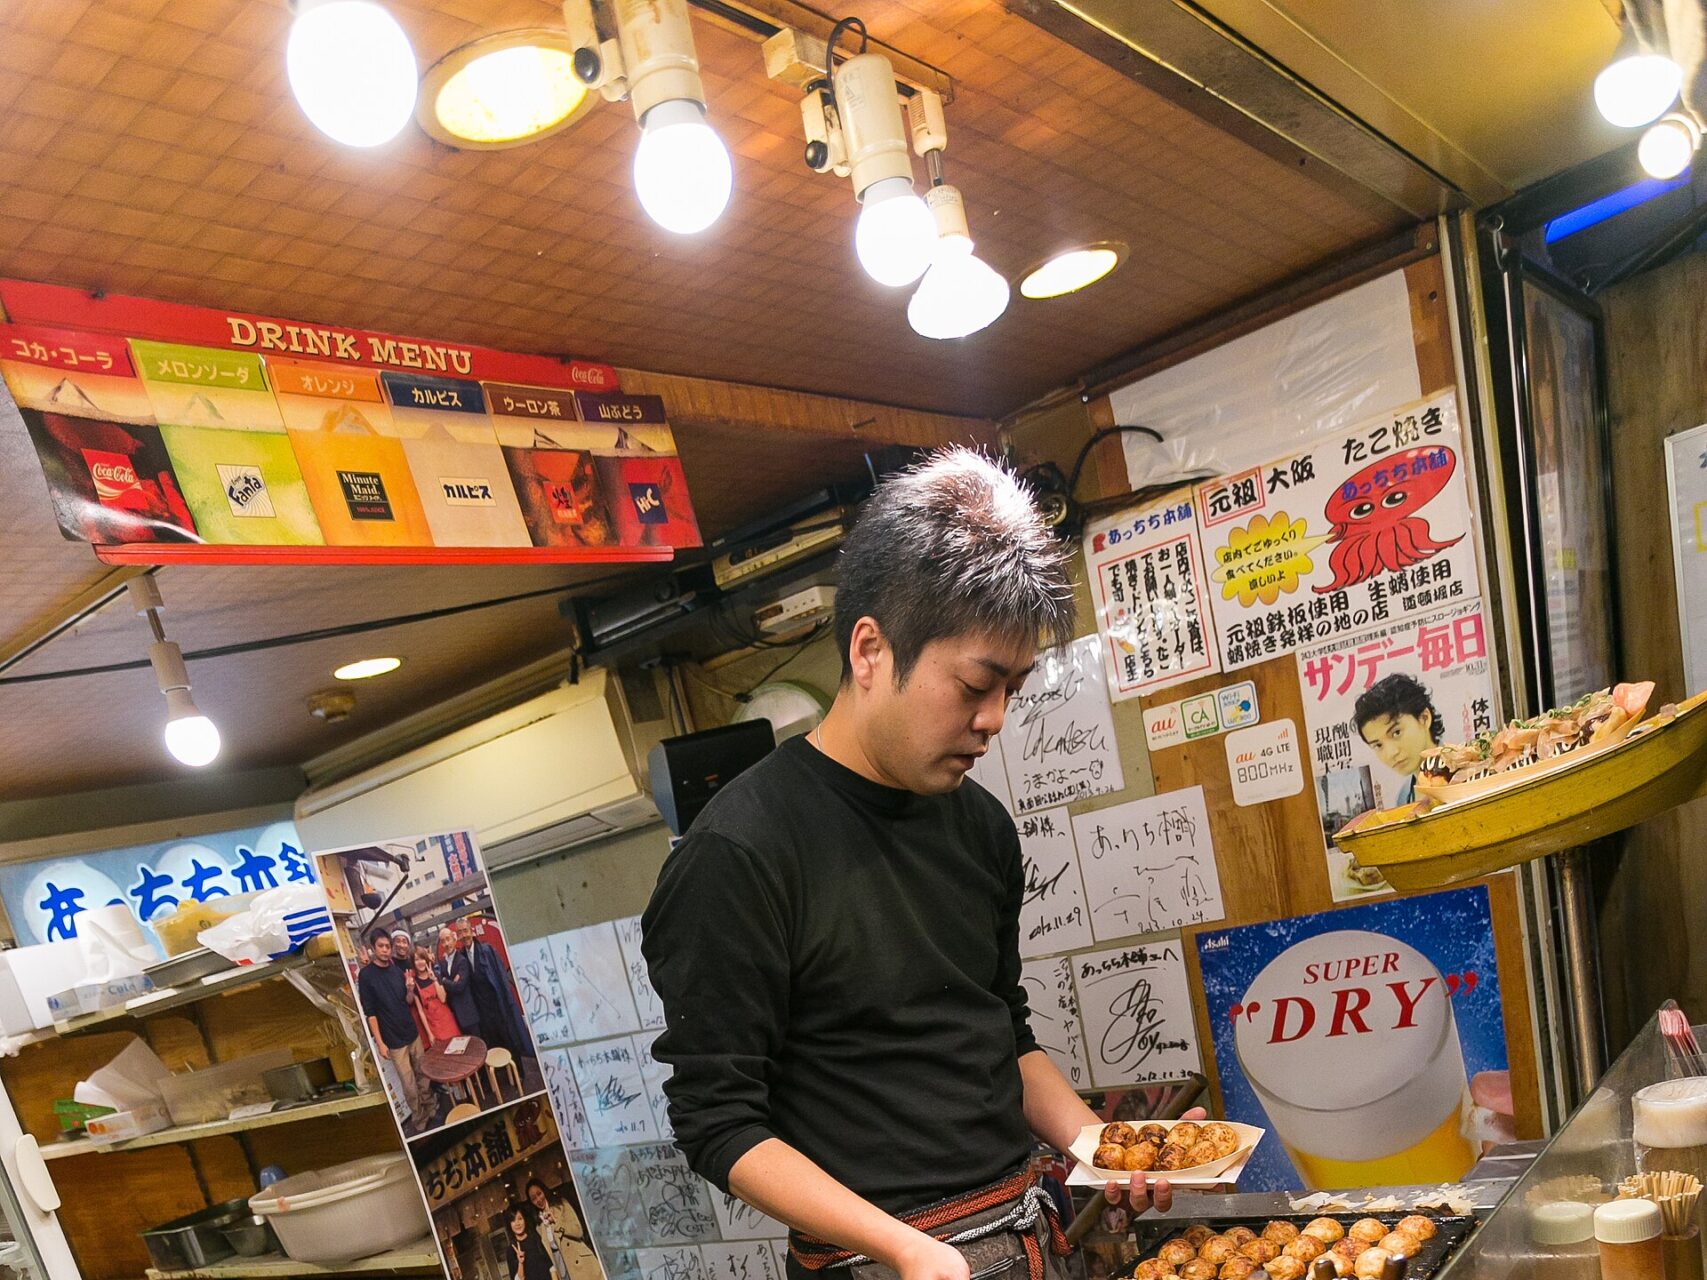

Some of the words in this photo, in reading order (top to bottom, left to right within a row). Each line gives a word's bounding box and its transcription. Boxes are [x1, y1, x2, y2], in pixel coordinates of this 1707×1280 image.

[10, 339, 113, 370] コカ・コーラ
[226, 317, 362, 361] DRINK
[367, 337, 473, 375] MENU
[157, 359, 250, 384] メロンソーダ
[300, 375, 355, 395] オレンジ
[411, 387, 463, 408] カルピス
[502, 397, 562, 417] ウーロン茶
[598, 403, 643, 420] 山ぶどう
[1342, 407, 1444, 465] たこ焼き
[341, 472, 380, 485] Minute
[1208, 481, 1258, 517] 元祖
[1266, 455, 1316, 494] 大阪
[1342, 447, 1448, 501] あっちち本舗
[228, 475, 263, 507] Fanta
[443, 484, 492, 501] カルピス
[1107, 502, 1193, 545] あっちち本舗
[1226, 590, 1351, 647] 元祖鉄板使用
[1367, 558, 1452, 601] 生蛸使用
[1226, 600, 1390, 666] 蛸焼き発祥の地の店
[1303, 612, 1487, 703] サンデー毎日
[1151, 717, 1177, 734] au
[1190, 707, 1210, 725] CA
[1235, 751, 1257, 764] au
[1260, 747, 1274, 758] 4G
[1276, 742, 1291, 754] LTE
[39, 841, 318, 943] あちち本
[1204, 934, 1230, 950] Asahi
[1302, 952, 1400, 985] SUPER
